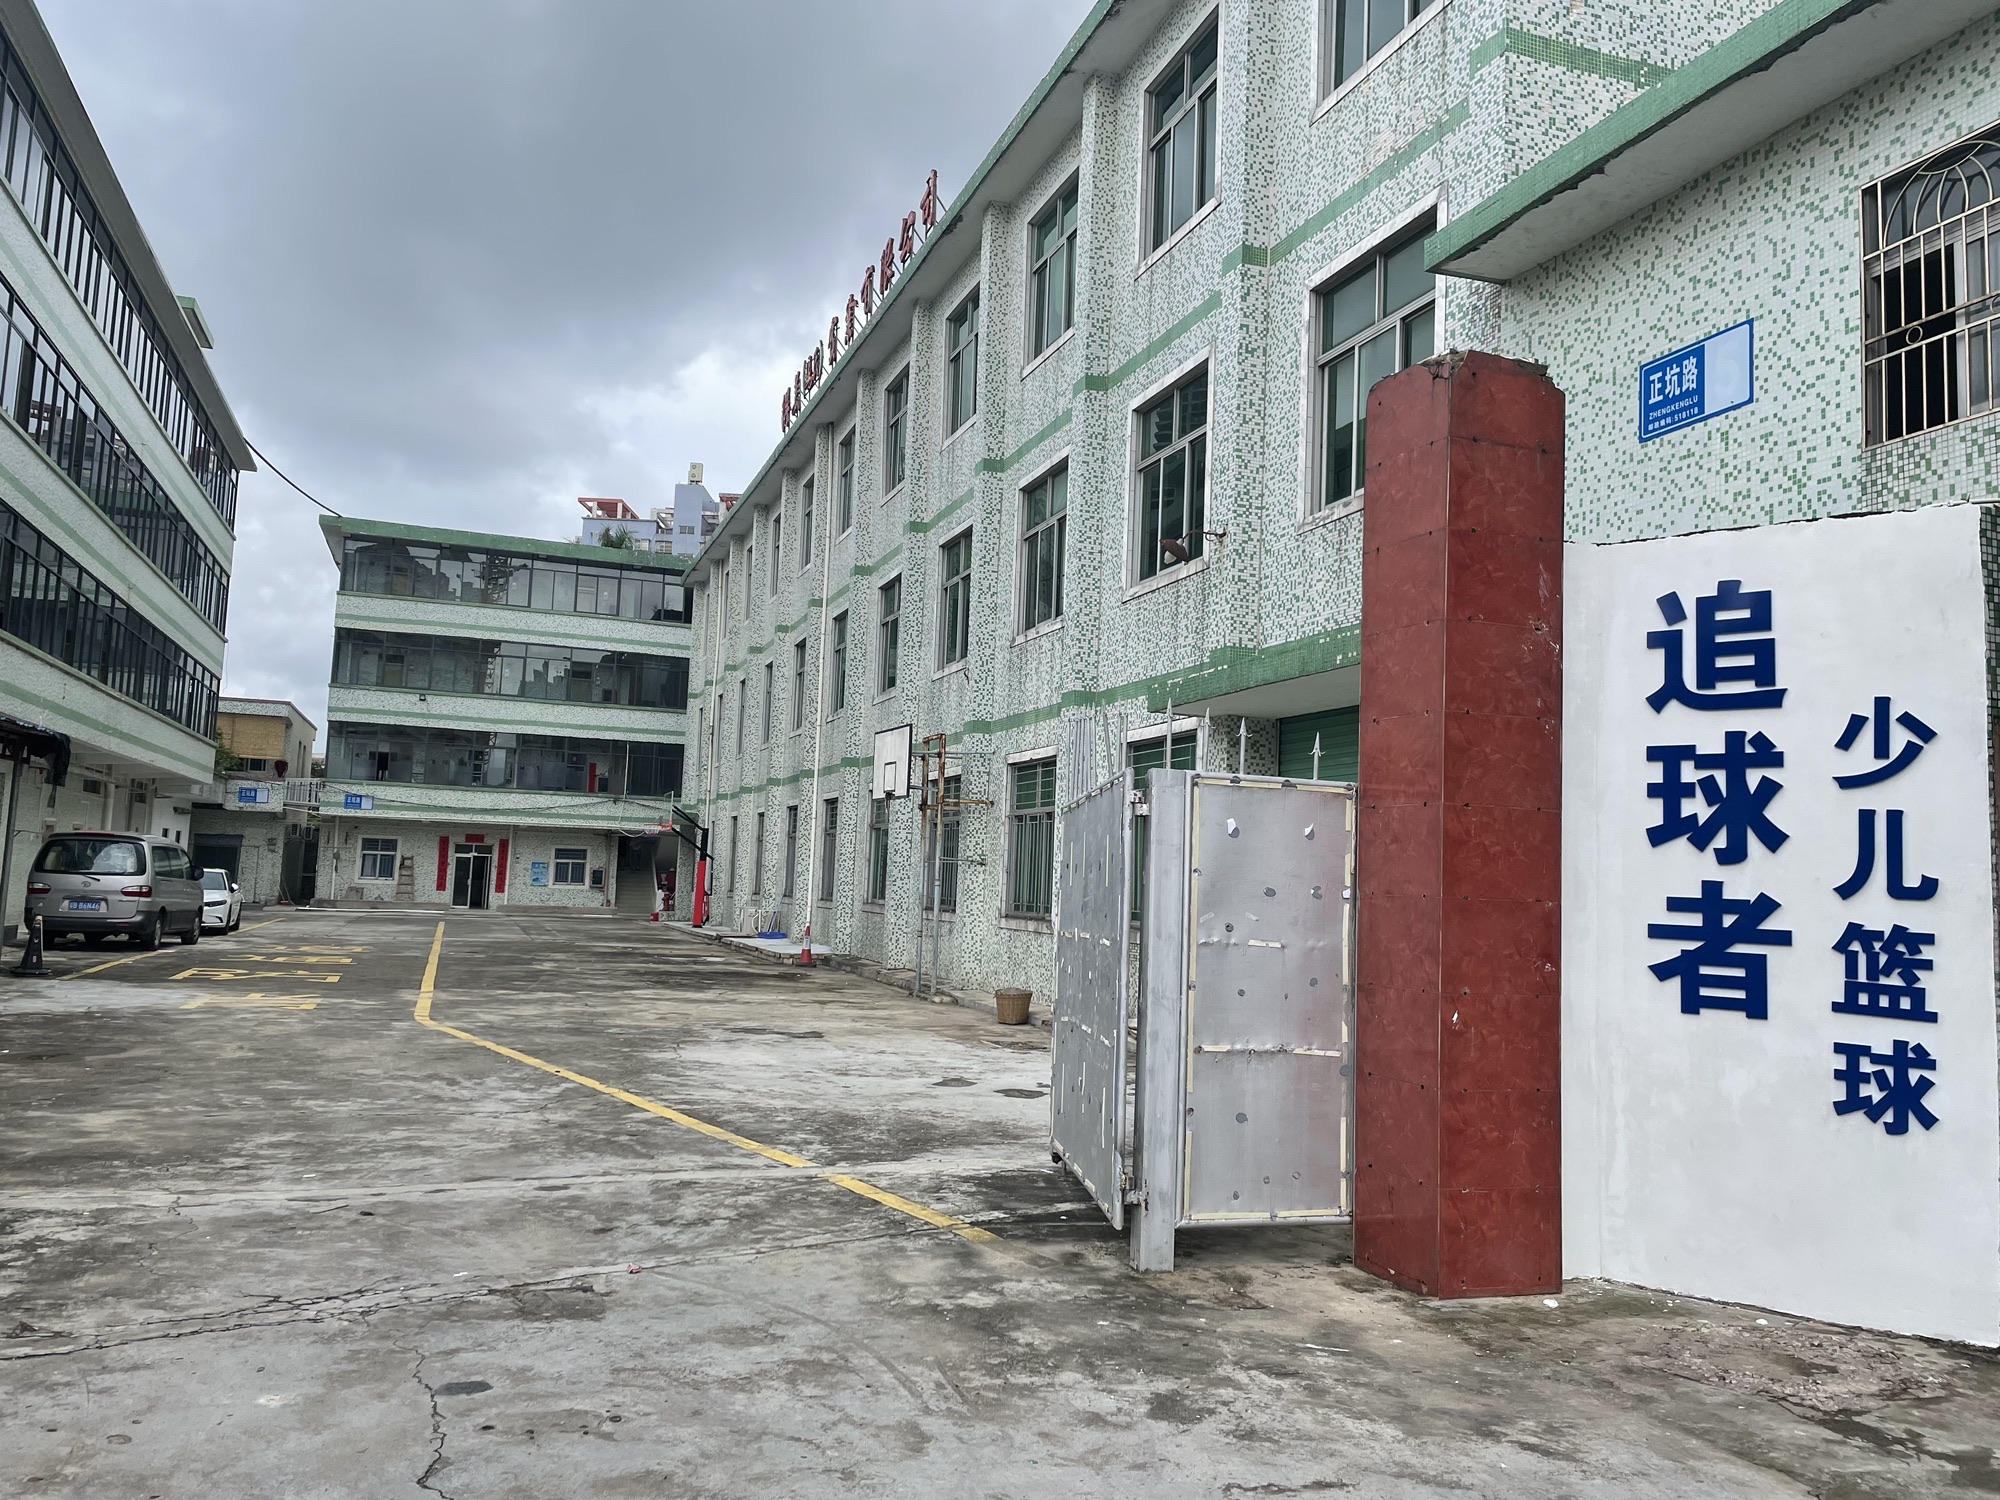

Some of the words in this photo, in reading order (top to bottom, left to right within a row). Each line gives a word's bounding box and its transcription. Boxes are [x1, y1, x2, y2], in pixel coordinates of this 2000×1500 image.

[1648, 355, 1698, 405] 正坑路
[1649, 395, 1698, 420] ZHENGKENGLU
[1645, 579, 1793, 1020] 追球者
[1831, 696, 1940, 1136] 少儿篮球
